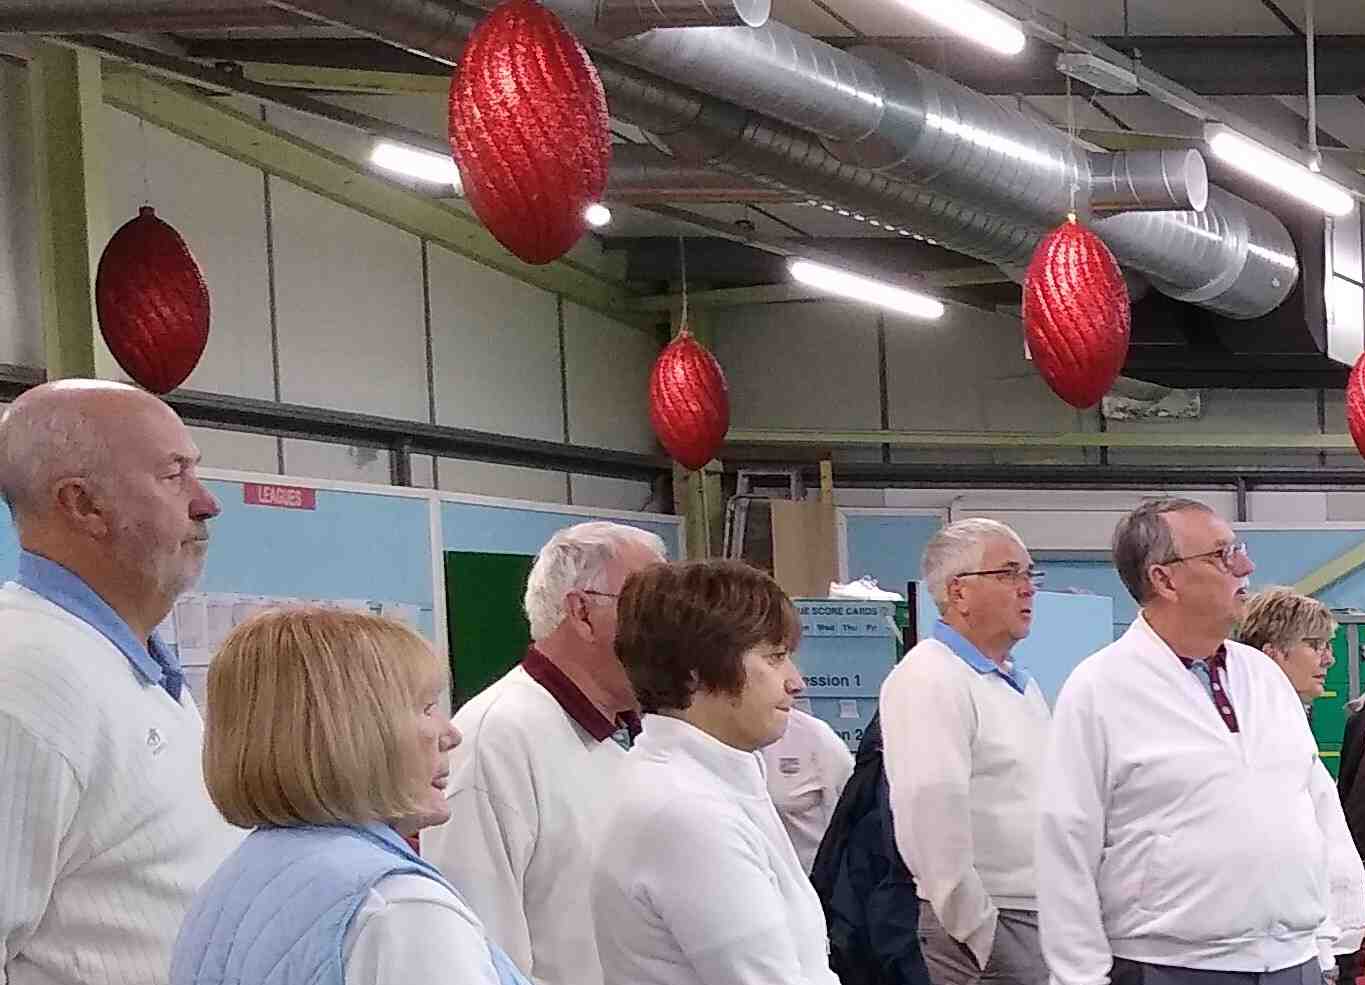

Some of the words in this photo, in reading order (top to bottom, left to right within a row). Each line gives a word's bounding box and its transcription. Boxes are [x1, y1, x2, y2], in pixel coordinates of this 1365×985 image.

[811, 606, 844, 616] SCORE
[845, 606, 878, 616] CARDS
[805, 673, 850, 687] ession
[854, 674, 862, 687] 1
